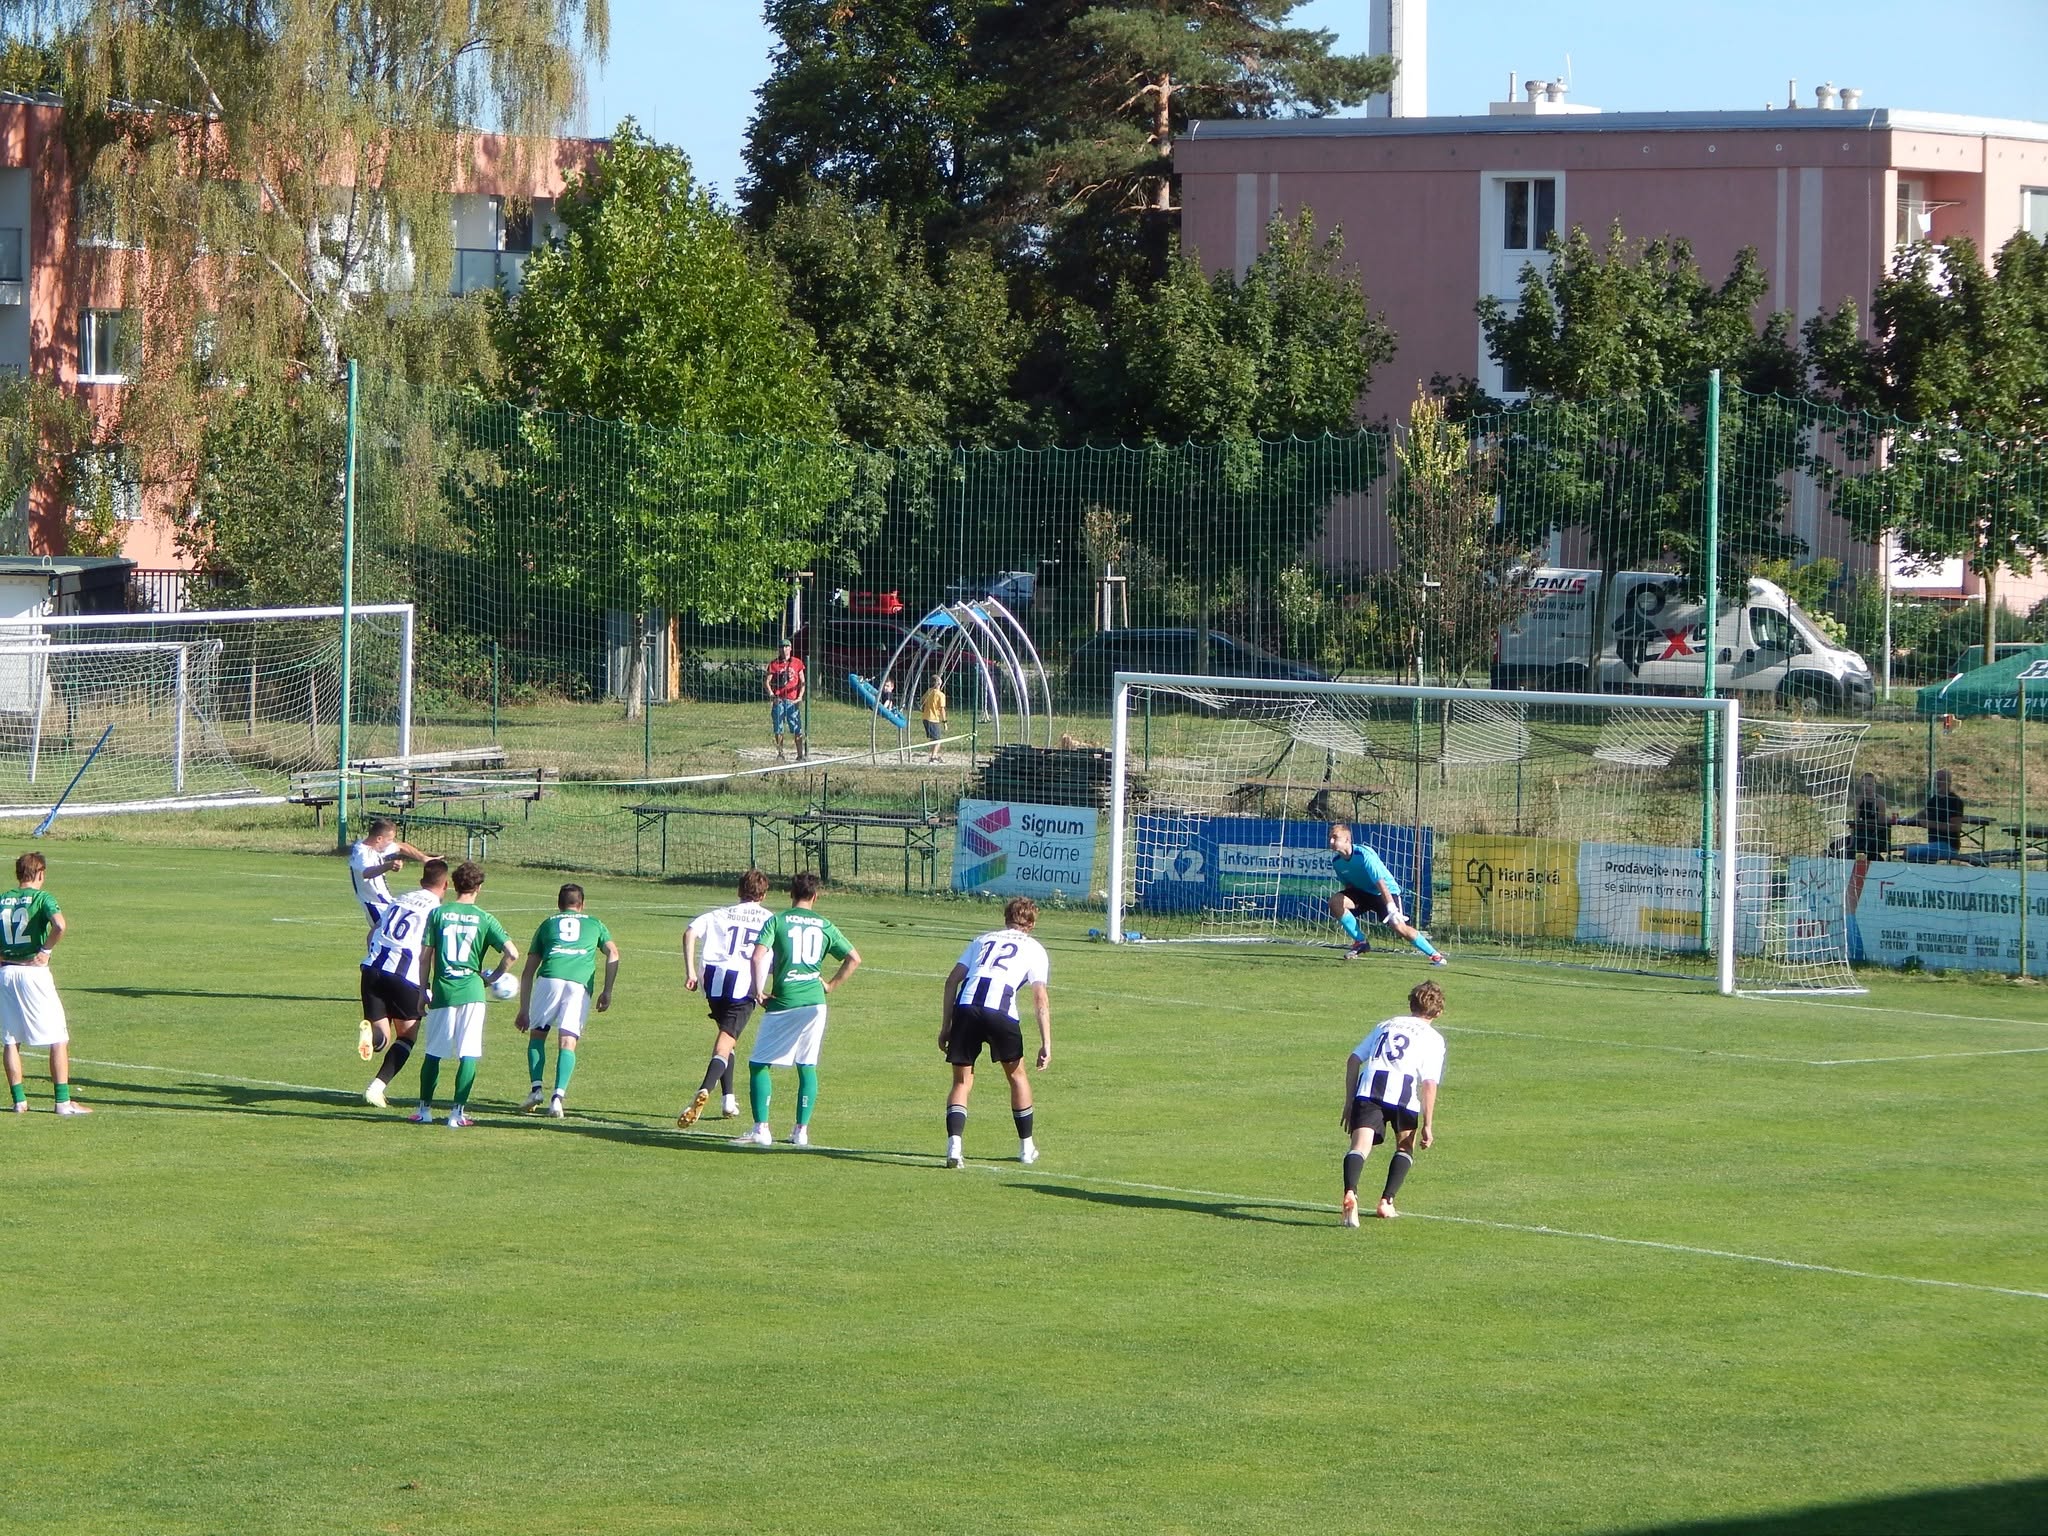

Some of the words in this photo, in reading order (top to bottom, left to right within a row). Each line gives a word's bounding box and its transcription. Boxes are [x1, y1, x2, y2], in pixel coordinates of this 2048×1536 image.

[1524, 577, 1587, 590] ANIS
[1021, 812, 1084, 837] Signum
[1018, 840, 1080, 862] Děláme
[1015, 864, 1081, 885] reklamu
[1298, 854, 1334, 874] systé
[1605, 860, 1669, 878] Prodávejte
[1604, 882, 1617, 892] se
[1619, 881, 1653, 896] silným
[0, 907, 32, 945] 12
[383, 905, 415, 940] 16
[559, 917, 581, 942] 9
[442, 924, 478, 963] 17
[727, 926, 761, 960] 15
[787, 925, 824, 965] 10
[981, 940, 1018, 971] 12
[1373, 1031, 1410, 1061] 13
